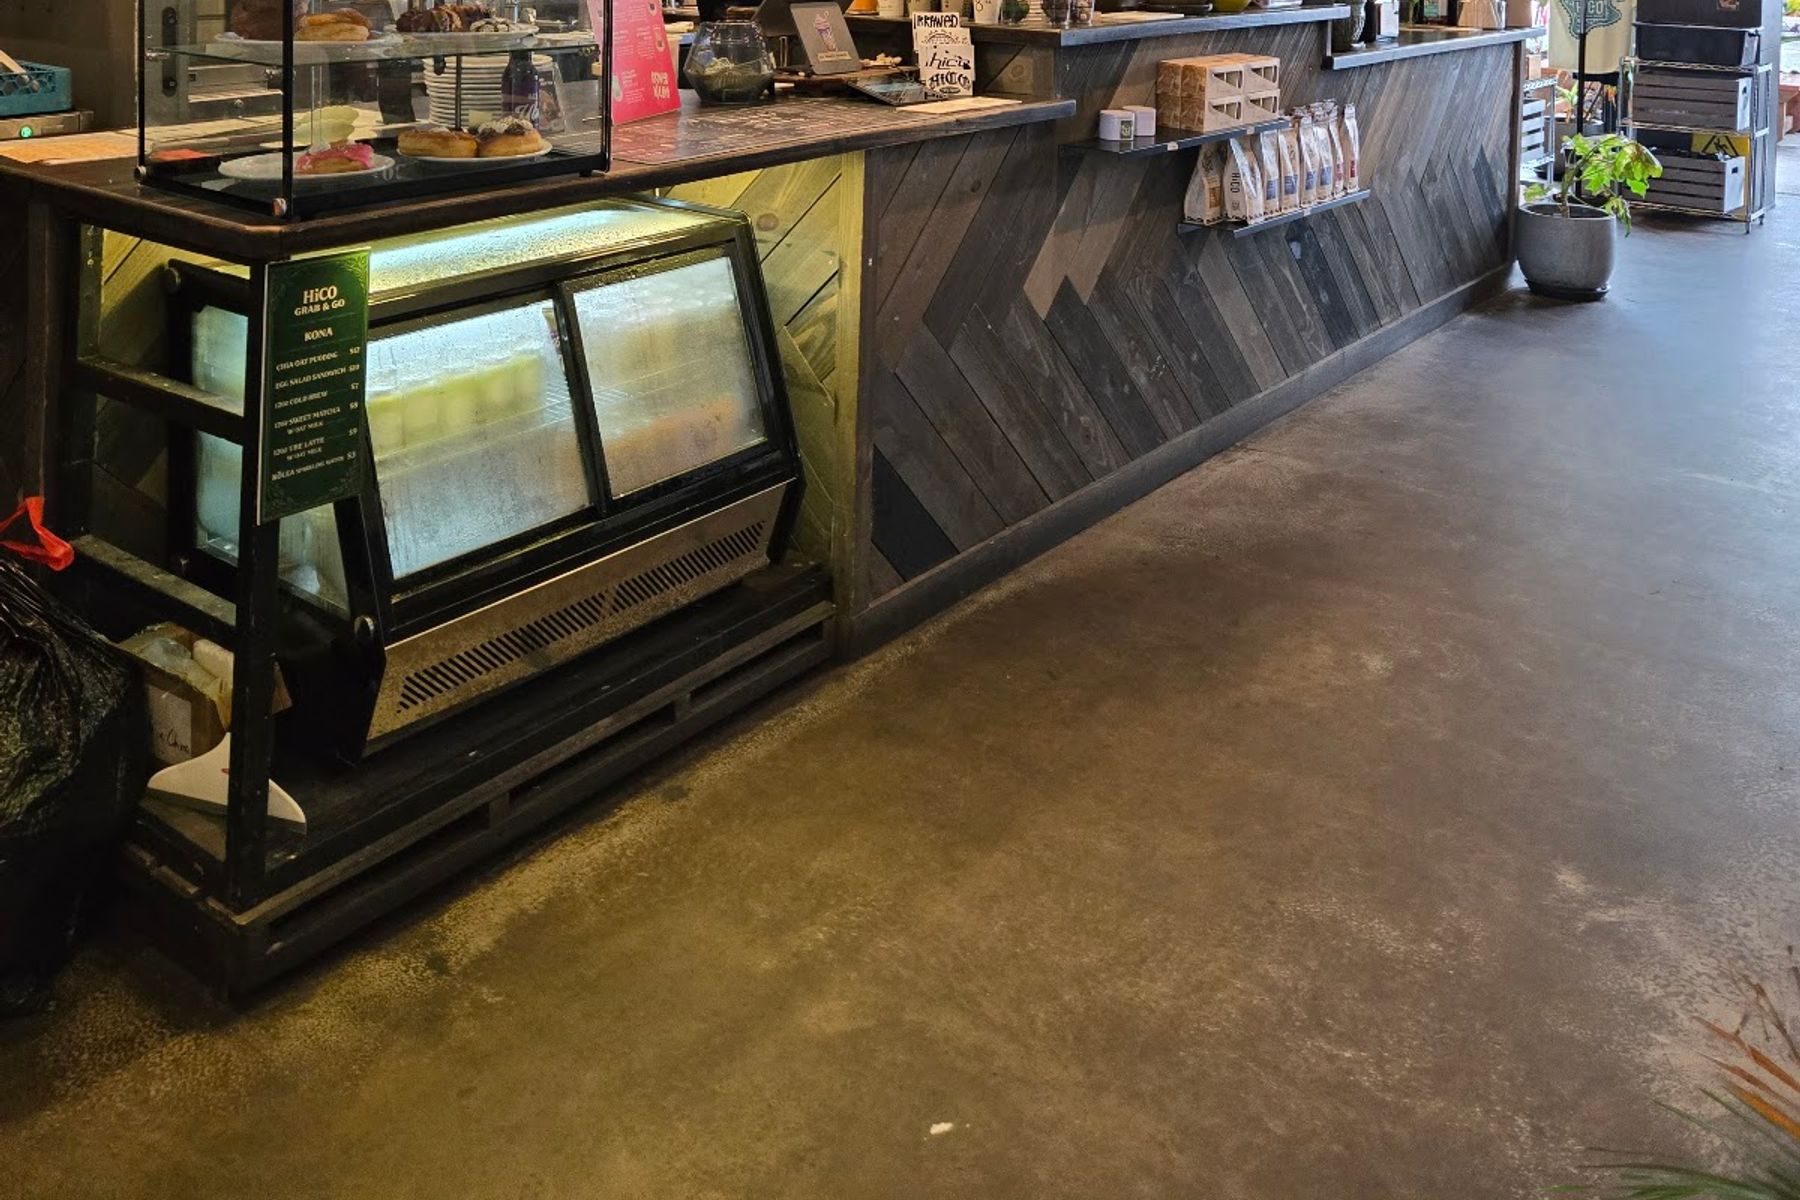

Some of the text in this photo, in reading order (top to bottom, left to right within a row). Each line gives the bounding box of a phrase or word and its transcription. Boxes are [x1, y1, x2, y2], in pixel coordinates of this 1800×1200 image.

[303, 285, 338, 304] HiCO
[294, 298, 345, 316] GRAB & GO
[304, 327, 334, 342] KONA
